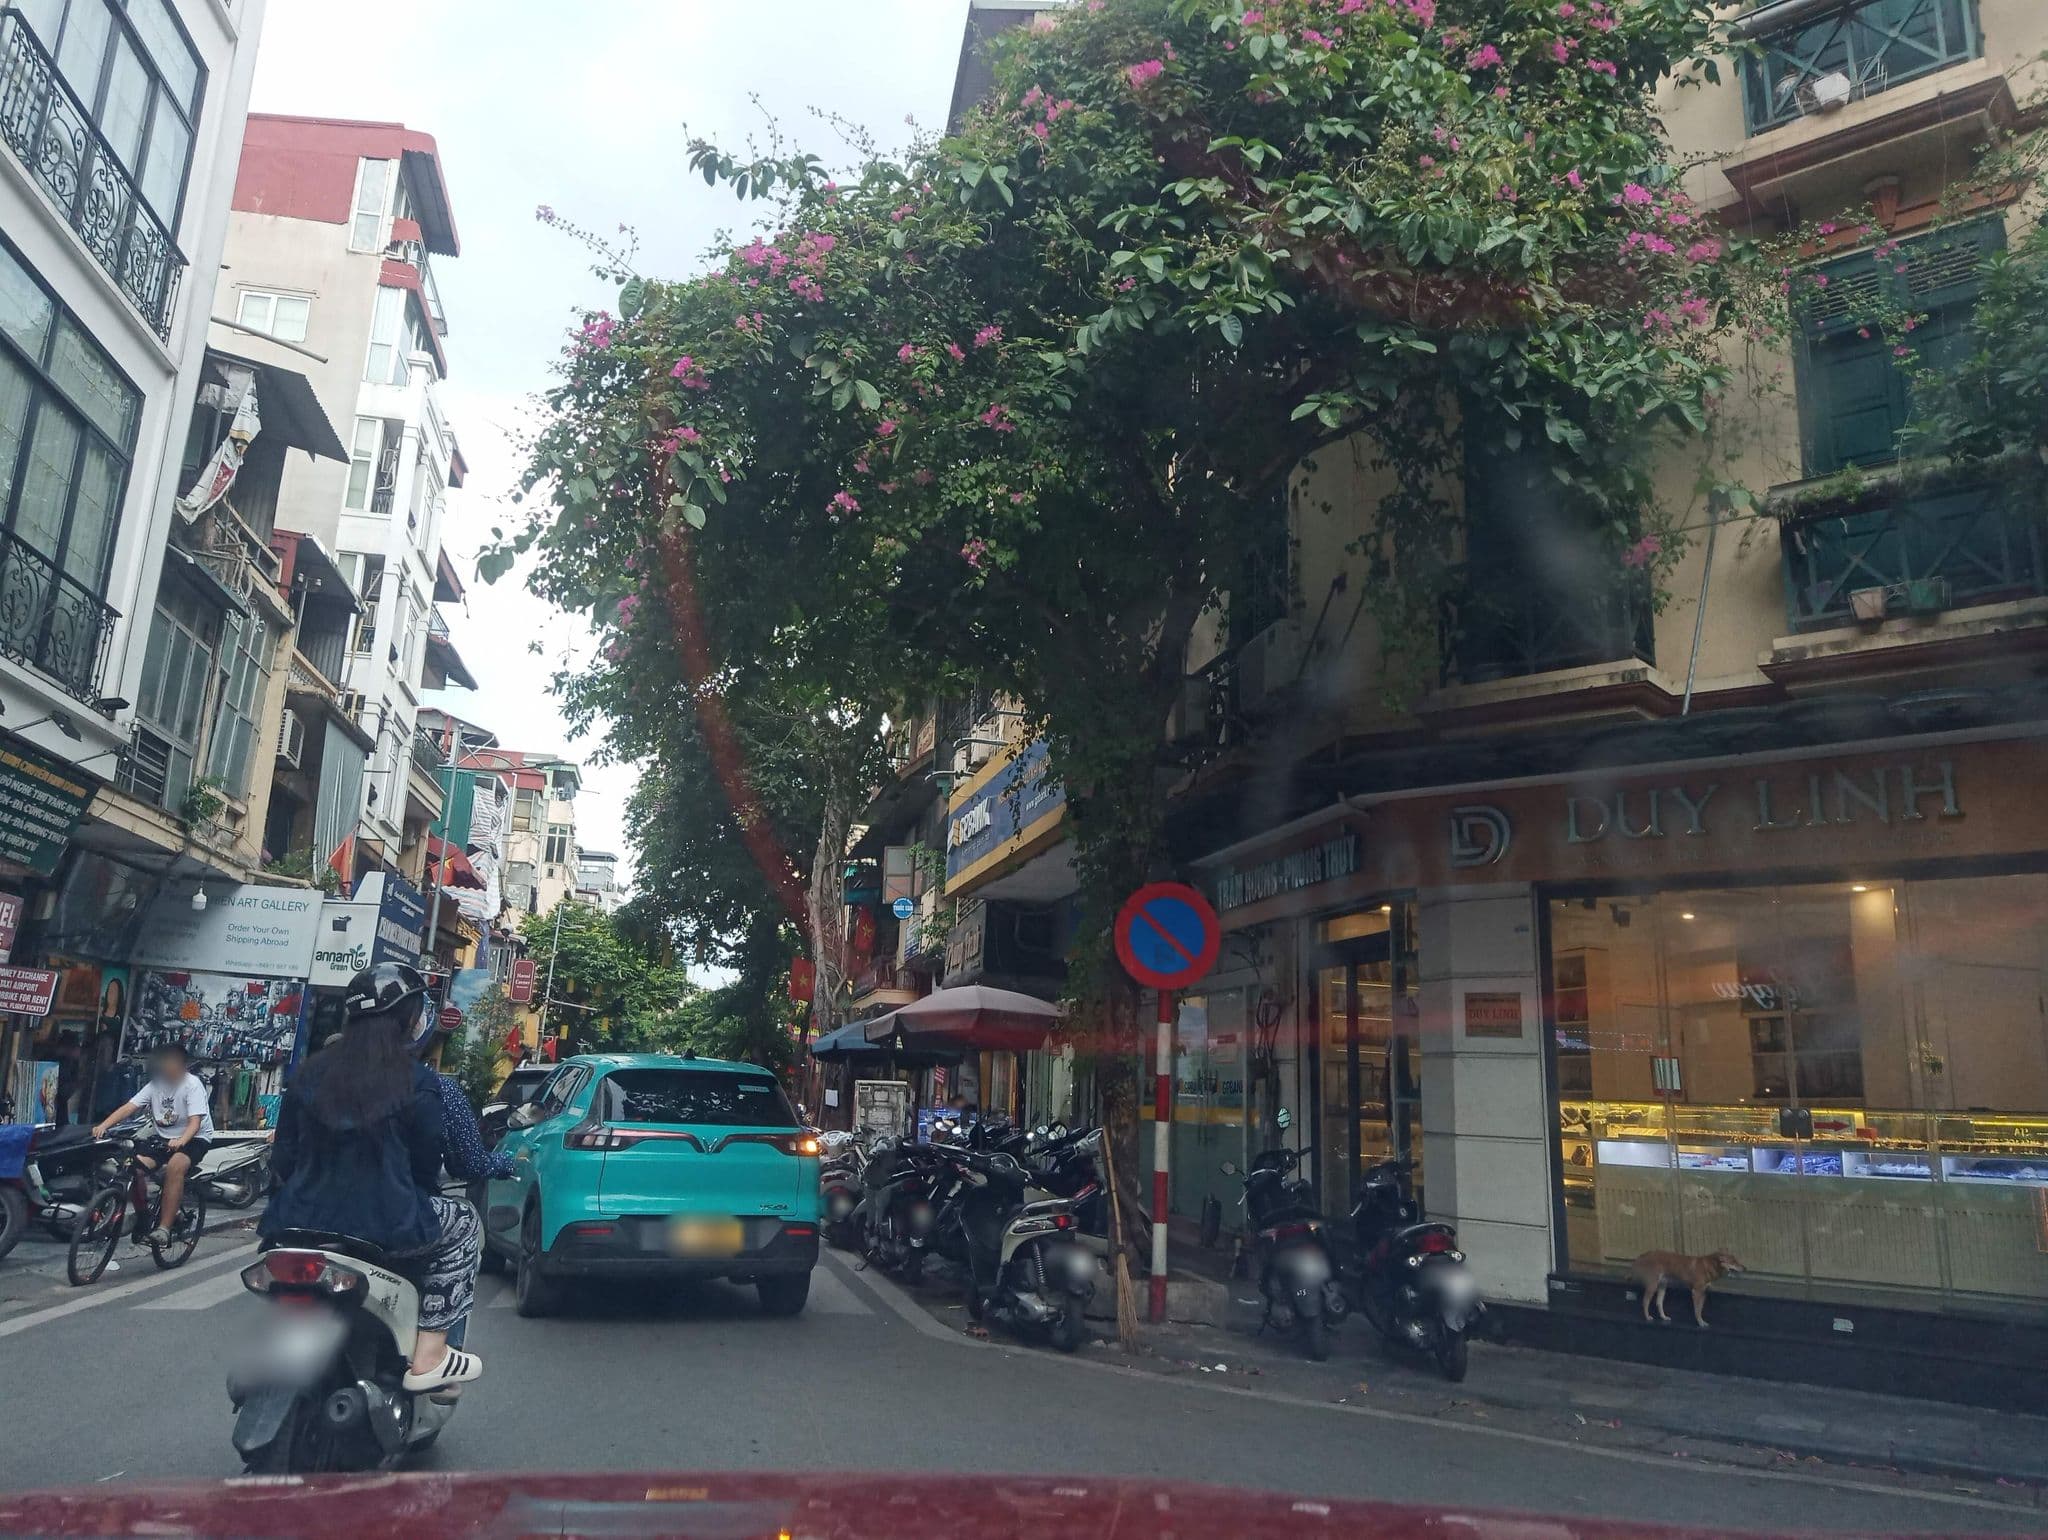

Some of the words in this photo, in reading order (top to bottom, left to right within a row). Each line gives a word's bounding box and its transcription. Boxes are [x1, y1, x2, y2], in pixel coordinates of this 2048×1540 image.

[1567, 785, 1719, 843] DUY
[1752, 762, 1963, 832] LINH
[237, 897, 260, 909] ART
[261, 899, 310, 912] GALLERY
[228, 923, 250, 932] Order
[252, 925, 270, 934] Your
[271, 926, 290, 935] Own
[226, 934, 259, 946] Shipping
[260, 937, 289, 947] Abroad
[17, 970, 49, 983] EXCHANGE
[13, 981, 38, 992] AIRPORT
[19, 993, 31, 1003] FOR
[32, 995, 48, 1005] RENT
